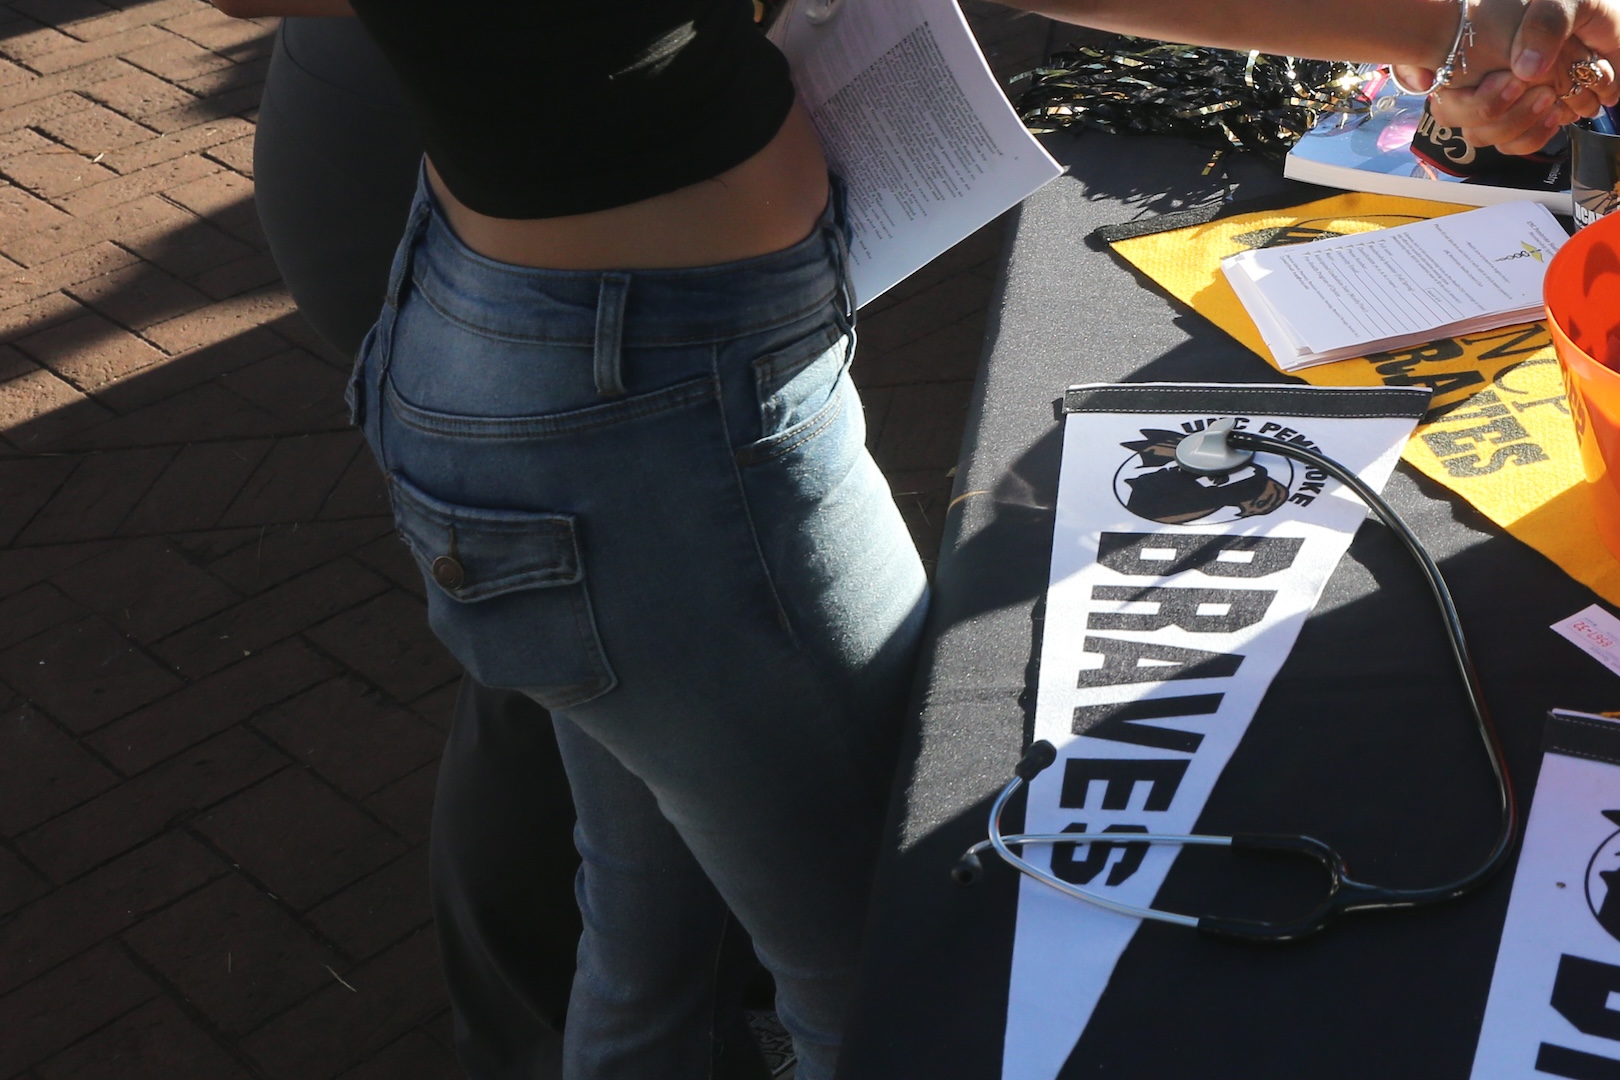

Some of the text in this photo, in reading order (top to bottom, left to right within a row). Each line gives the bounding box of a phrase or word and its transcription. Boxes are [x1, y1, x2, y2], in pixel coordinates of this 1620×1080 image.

[1258, 421, 1329, 508] PEMOKE
[1363, 336, 1550, 477] RAVES
[1050, 531, 1306, 887] BRAVES
